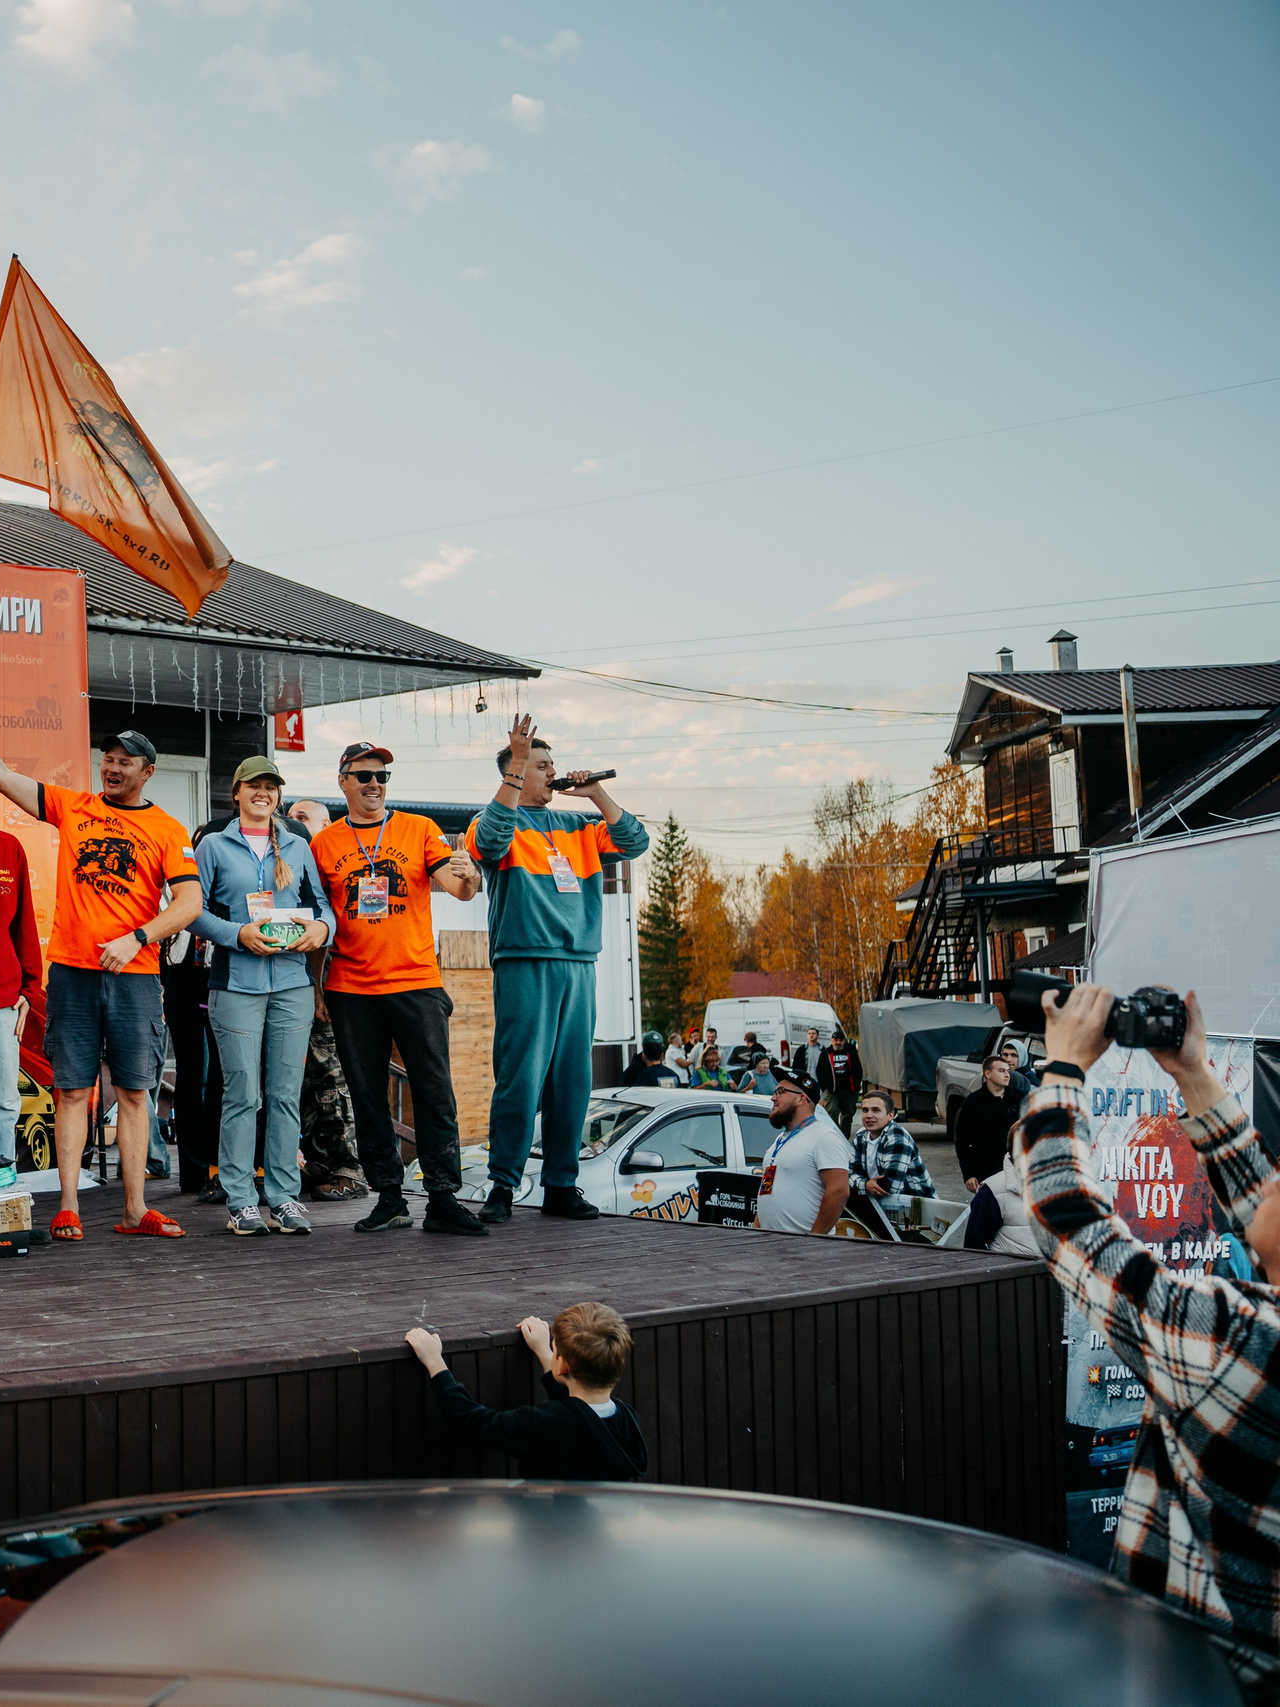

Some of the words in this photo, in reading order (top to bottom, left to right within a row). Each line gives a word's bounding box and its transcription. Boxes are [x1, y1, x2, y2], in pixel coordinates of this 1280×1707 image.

[385, 846, 409, 865] CLUB
[1091, 1087, 1144, 1117] DRIFT
[1149, 1088, 1169, 1117] IN
[1099, 1146, 1175, 1181] NIKITA
[1134, 1183, 1185, 1219] VOY
[1171, 1241, 1181, 1256] В
[1184, 1240, 1231, 1262] КАДРЕ
